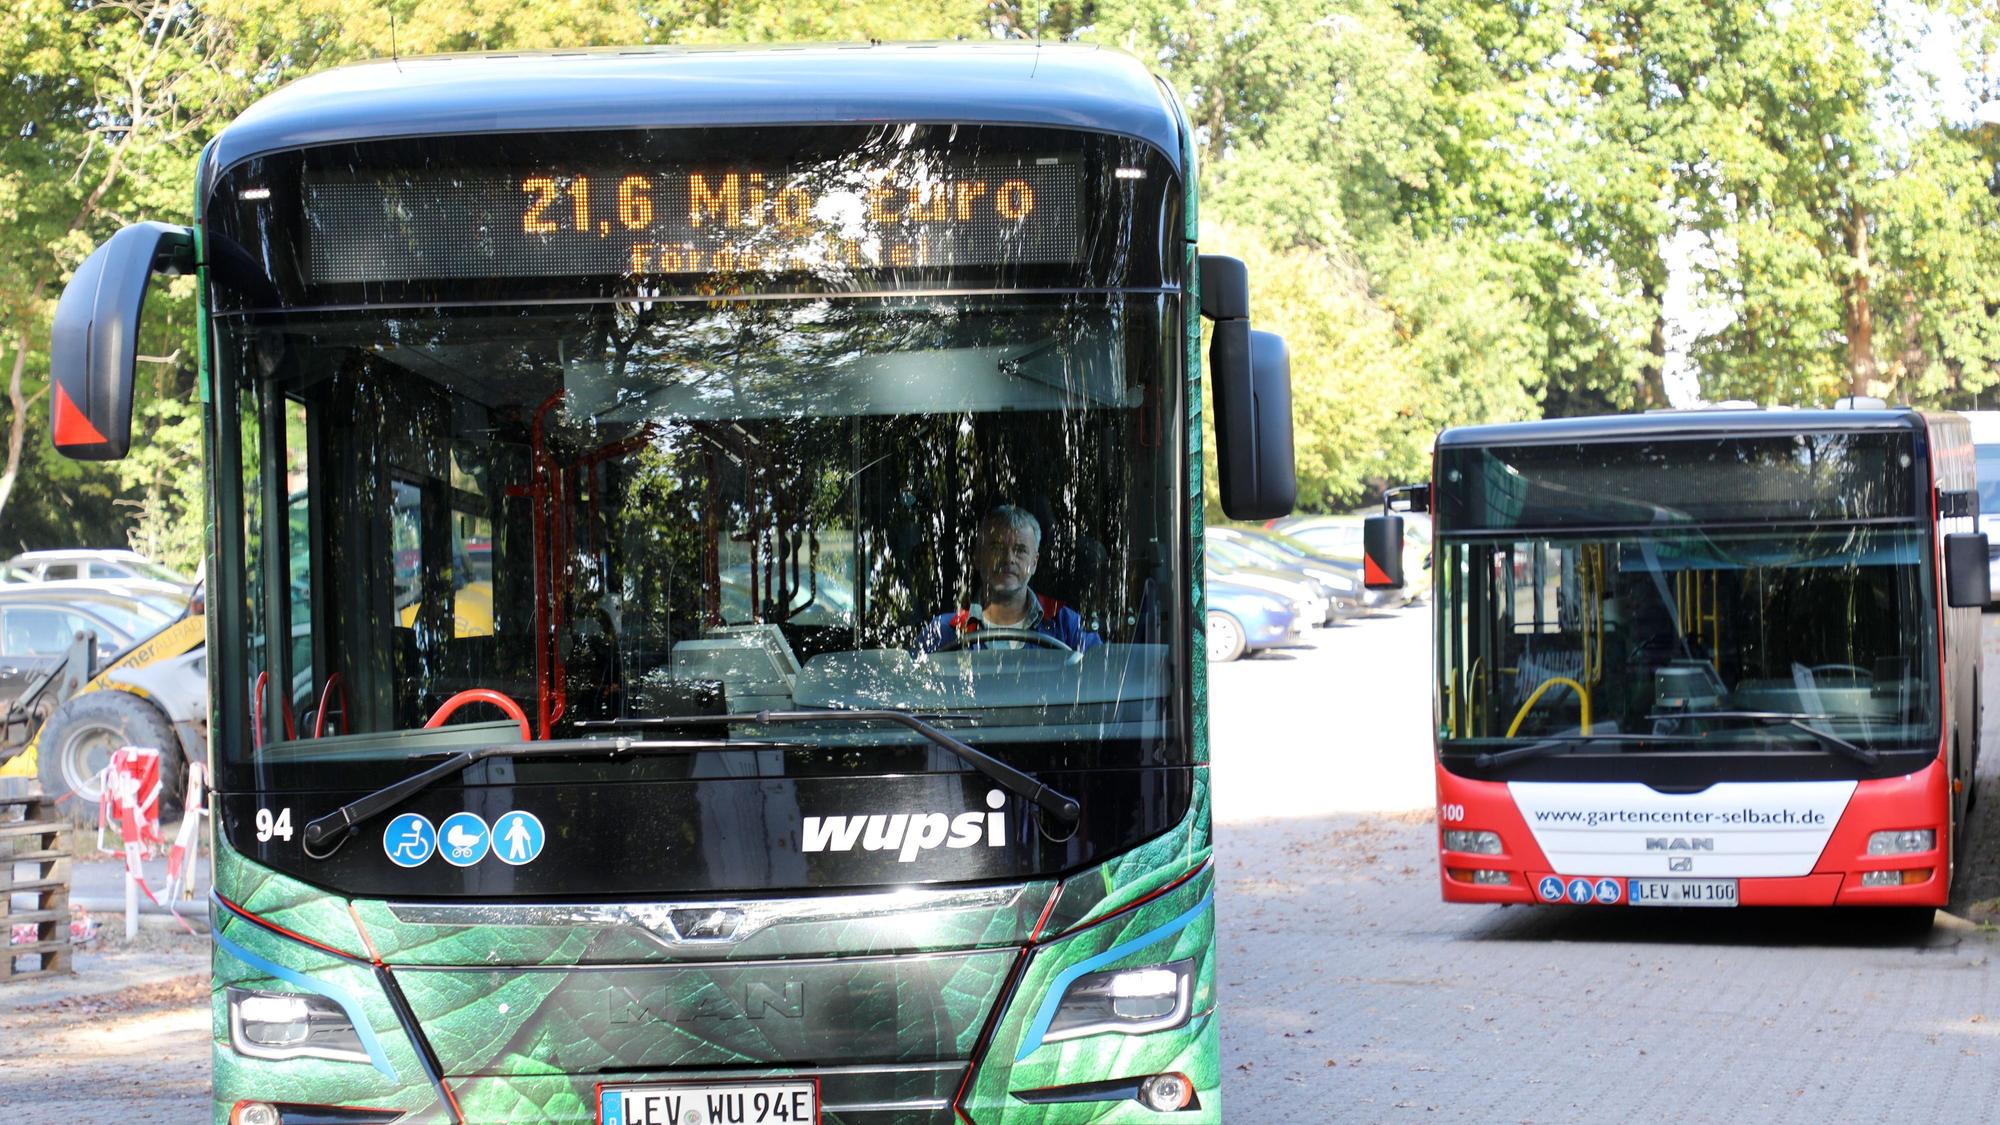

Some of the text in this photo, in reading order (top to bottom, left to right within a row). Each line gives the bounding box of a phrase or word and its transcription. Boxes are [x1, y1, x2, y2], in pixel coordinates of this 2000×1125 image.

[522, 175, 653, 238] 21,6
[256, 808, 293, 842] 94
[802, 789, 1006, 863] wupsi
[1442, 804, 1464, 822] 100
[1535, 808, 1825, 827] www.gartencenter-selbach.de
[1646, 837, 1714, 851] MAN
[1640, 884, 1734, 900] LEV WU 100
[609, 981, 804, 1024] MAN
[625, 1096, 681, 1125] LEV
[707, 1094, 744, 1124] WU
[754, 1091, 809, 1123] 94E
